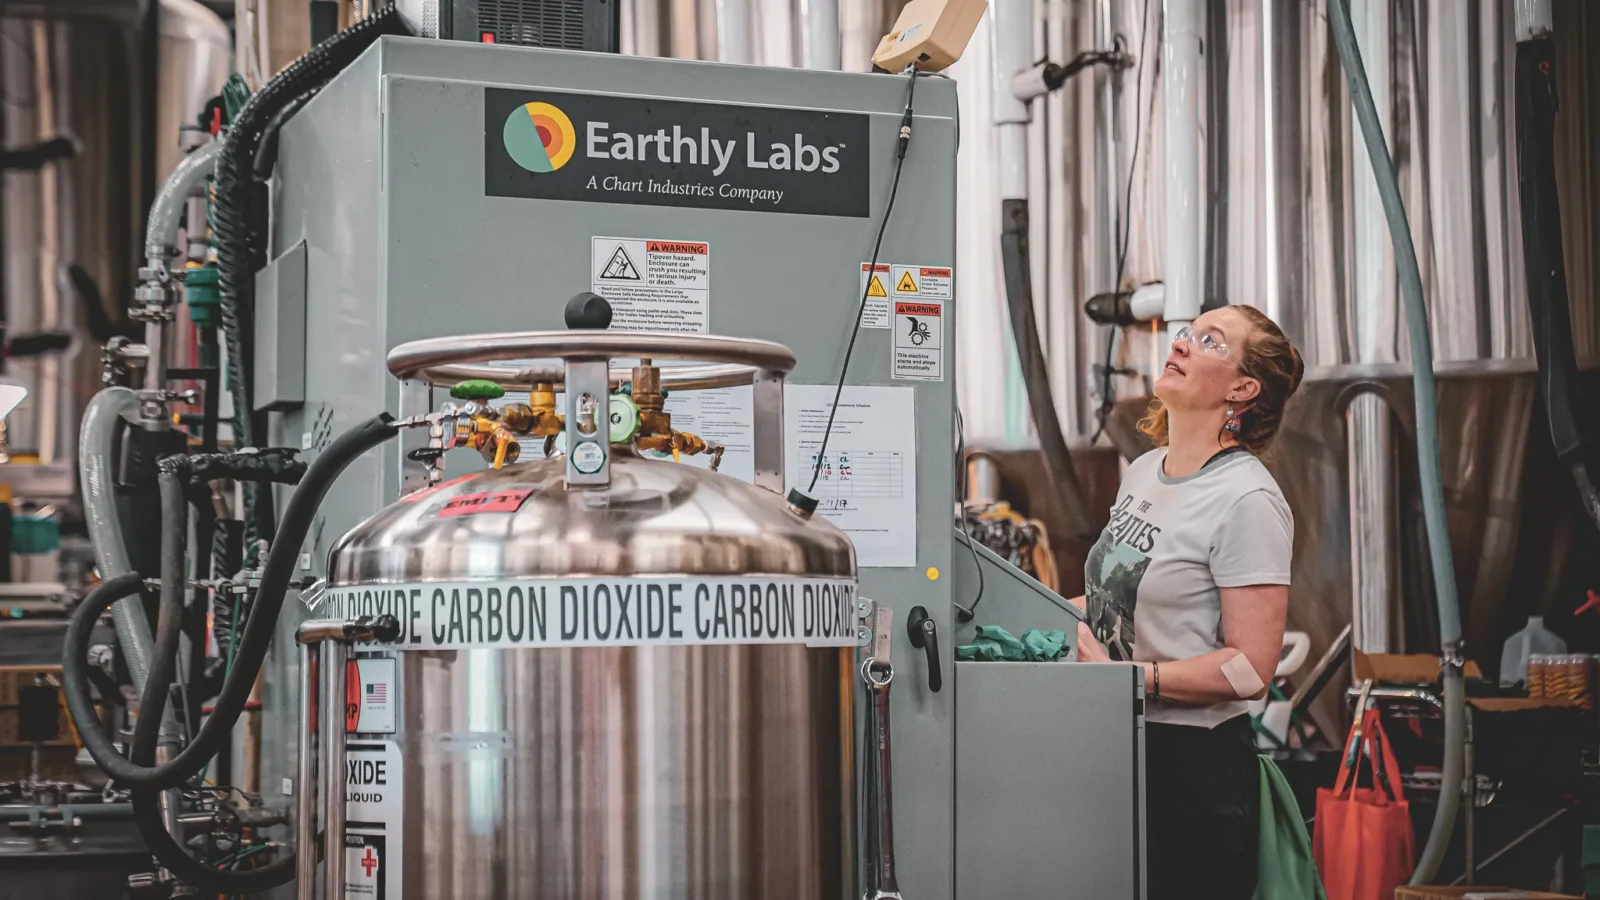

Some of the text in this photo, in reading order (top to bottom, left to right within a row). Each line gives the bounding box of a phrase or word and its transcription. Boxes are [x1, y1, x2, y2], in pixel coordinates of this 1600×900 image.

[586, 121, 736, 177] Earthly
[586, 175, 784, 203] A Chart Industries Company
[661, 244, 704, 254] WARNING
[649, 253, 696, 262] Tipover hazard.
[678, 268, 706, 276] resulting
[906, 305, 939, 314] WARNING
[1137, 499, 1153, 513] THE
[431, 585, 547, 645] CARBON
[559, 583, 683, 641] DIOXIDE
[694, 582, 795, 639] CARBON
[345, 759, 387, 785] XIDE
